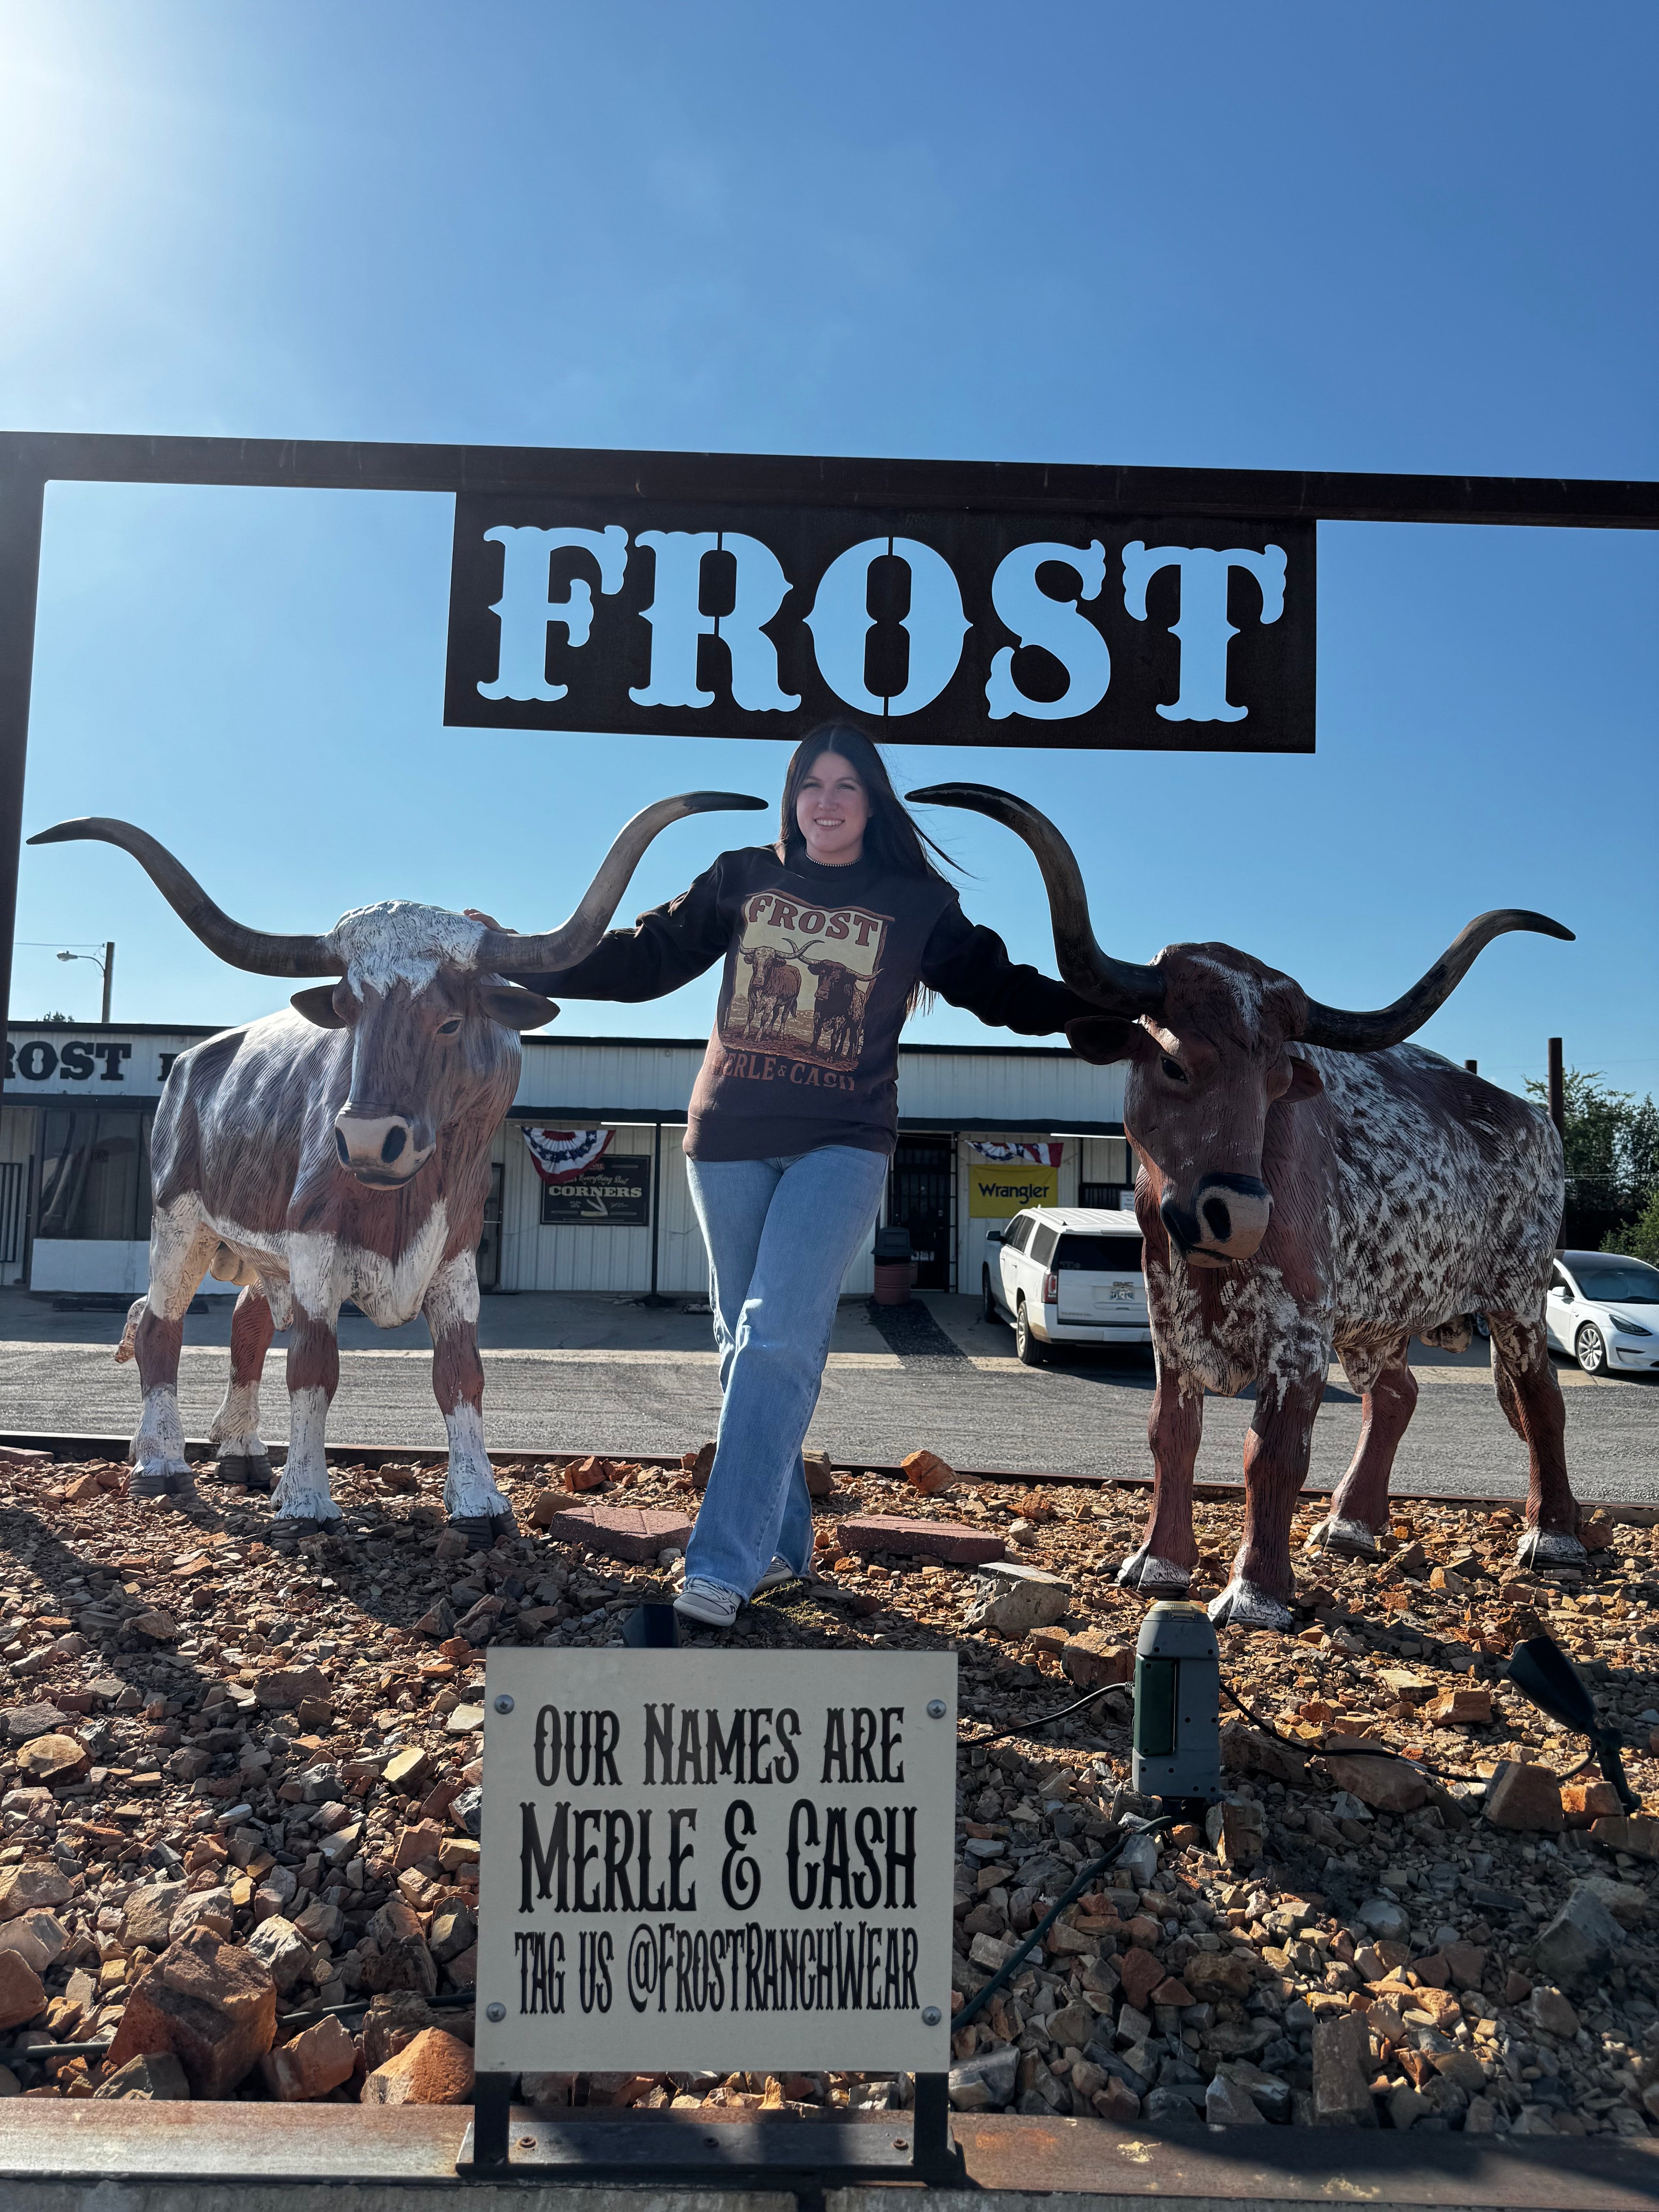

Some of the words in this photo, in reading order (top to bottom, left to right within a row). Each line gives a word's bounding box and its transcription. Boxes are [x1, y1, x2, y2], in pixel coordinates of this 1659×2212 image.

[477, 524, 1288, 723] FROST
[748, 895, 879, 947] FROST
[778, 1065, 787, 1077] &
[549, 1185, 642, 1198] CORNERS
[615, 1175, 629, 1185] But
[978, 1182, 1050, 1205] Wrangler
[533, 1704, 623, 1787] OUR
[642, 1702, 802, 1786] NAMES
[820, 1707, 905, 1784] ARE
[518, 1801, 698, 1914] MERLE
[721, 1799, 762, 1911] &
[785, 1798, 918, 1910] CASH
[514, 1931, 566, 2015] TAG
[578, 1930, 615, 2014] US
